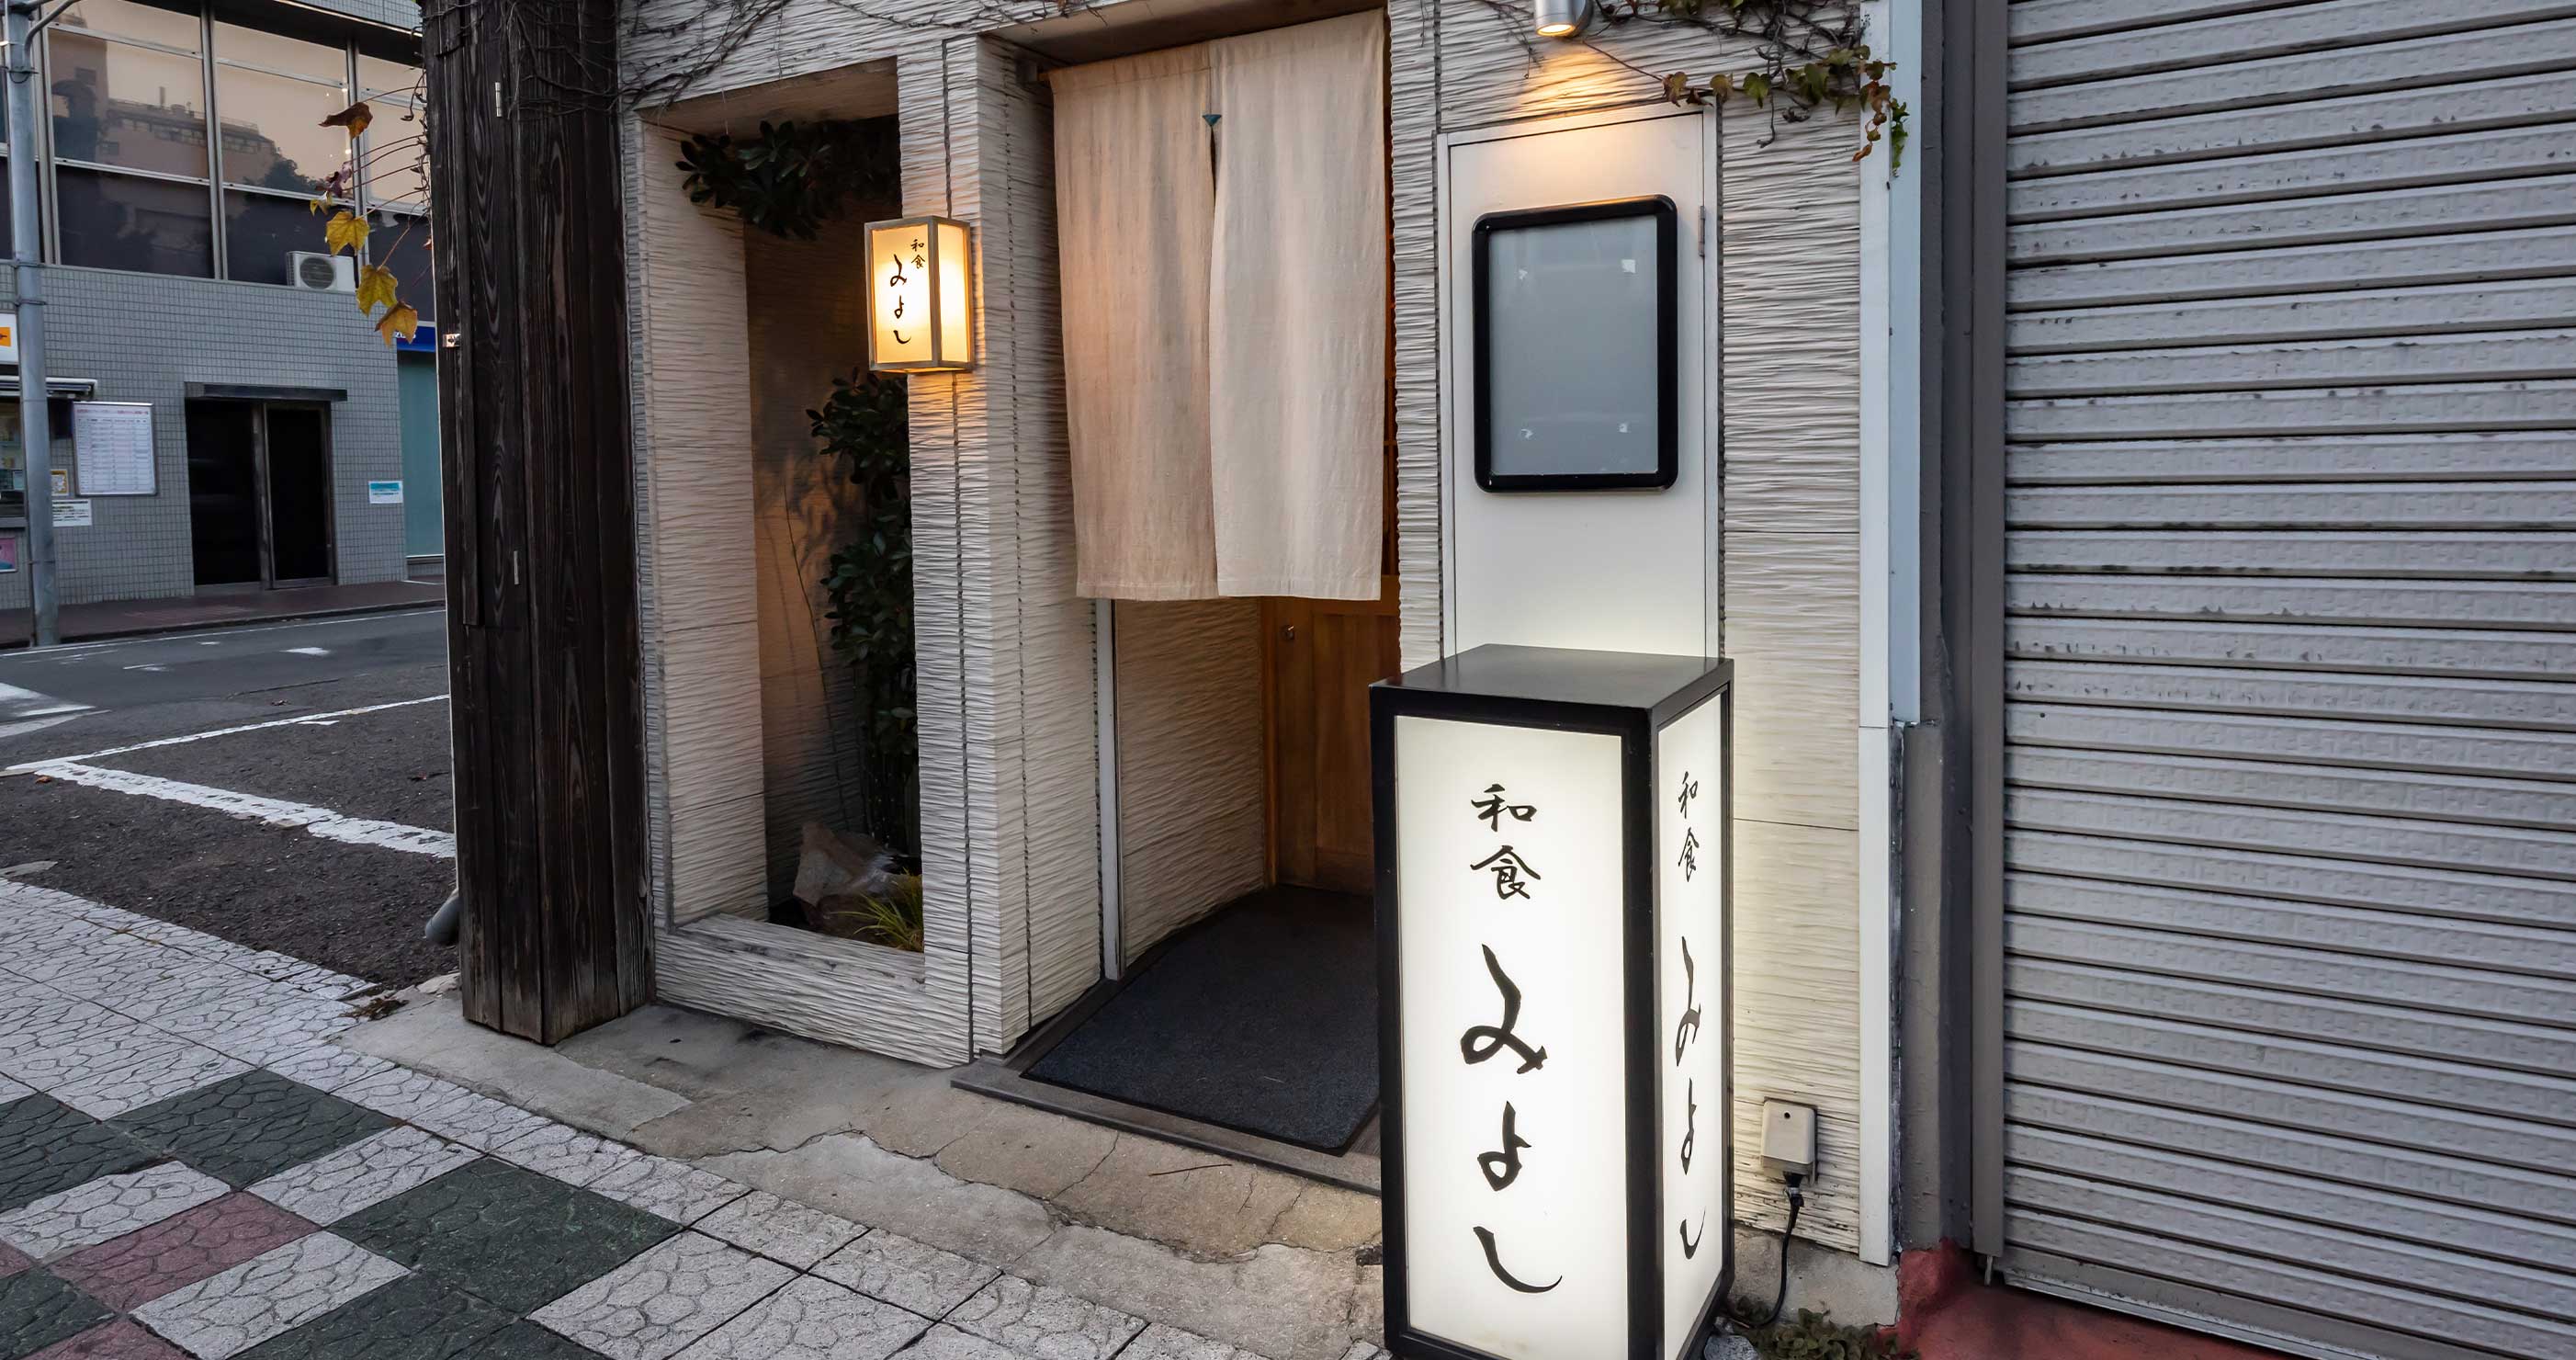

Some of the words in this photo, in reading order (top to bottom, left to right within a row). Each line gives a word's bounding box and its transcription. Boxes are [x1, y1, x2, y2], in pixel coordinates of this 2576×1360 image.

[889, 254, 912, 345] みよし
[910, 238, 926, 269] 和食
[1469, 783, 1542, 901] 和食
[1678, 771, 1700, 883] 和食
[1460, 944, 1563, 1294] みよし
[1675, 935, 1706, 1260] みよし
